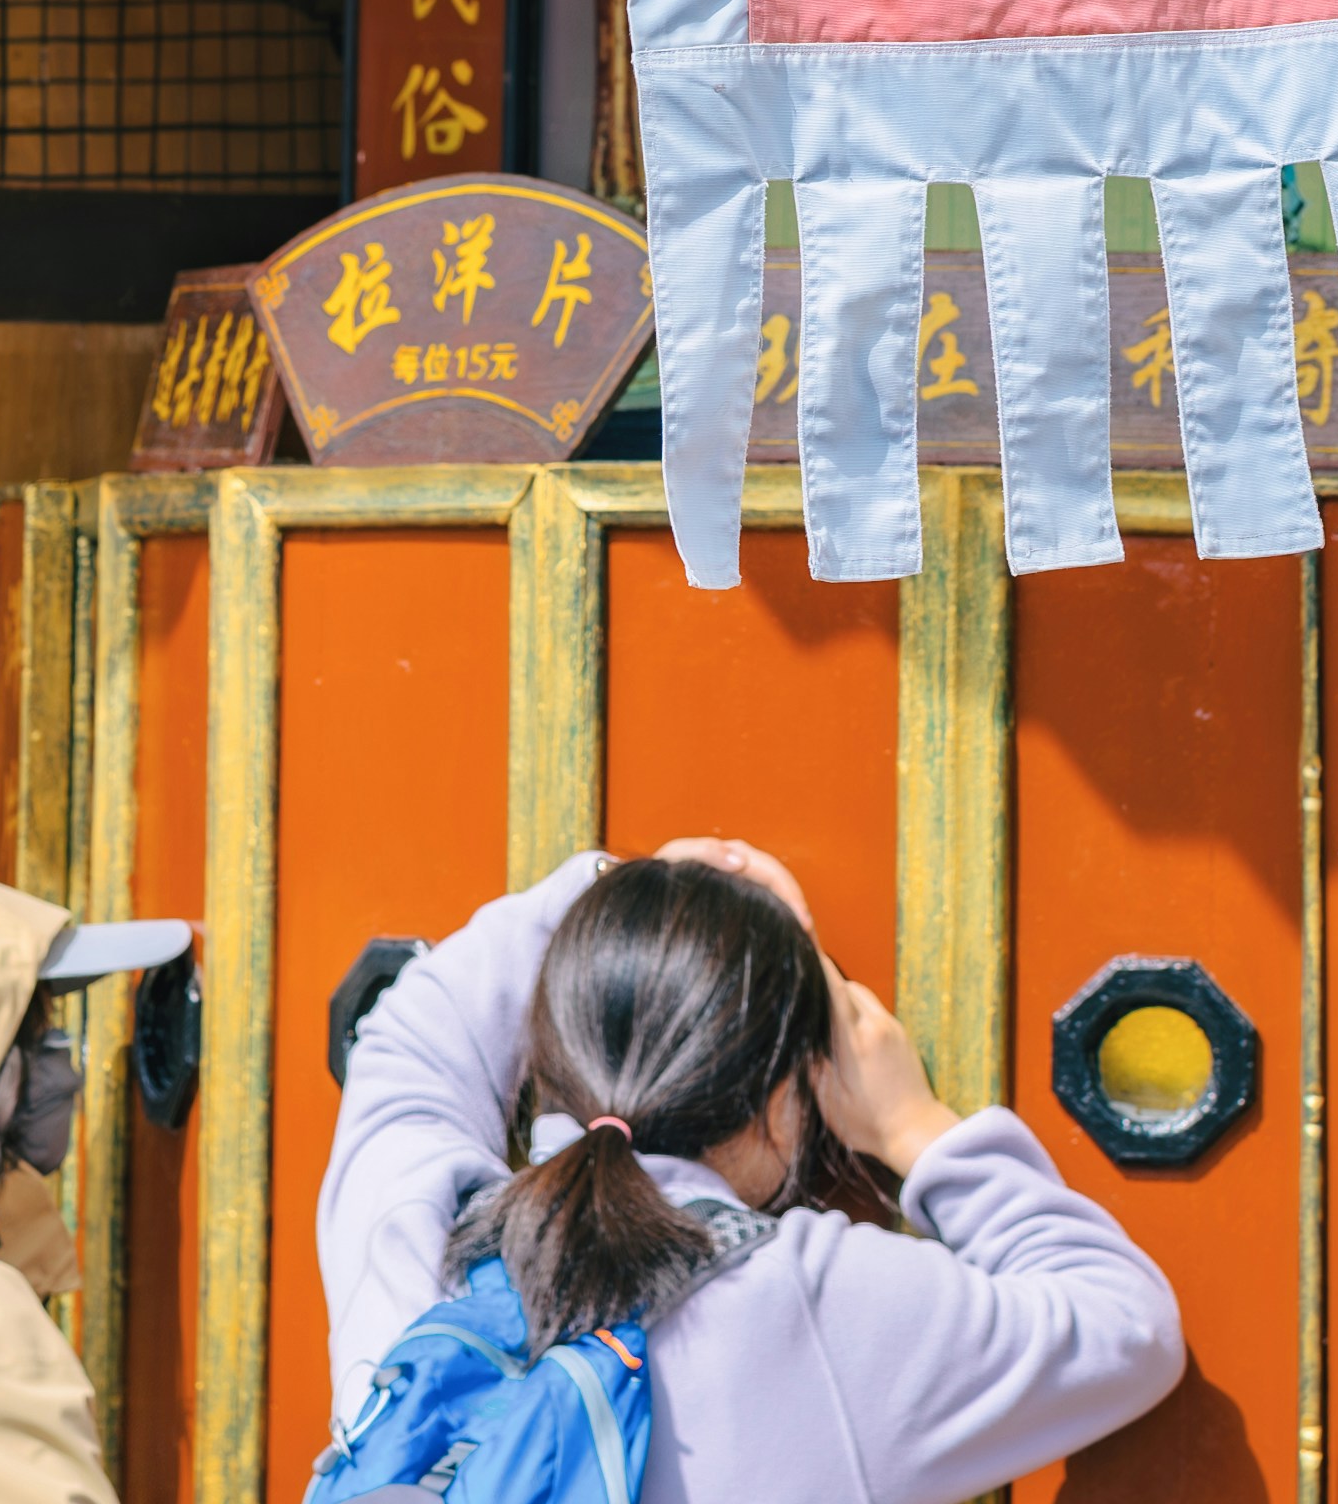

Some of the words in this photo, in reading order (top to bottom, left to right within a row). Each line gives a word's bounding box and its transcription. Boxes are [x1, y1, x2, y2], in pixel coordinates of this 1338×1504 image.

[321, 213, 592, 355] 拉洋片
[390, 343, 519, 386] 每位15元
